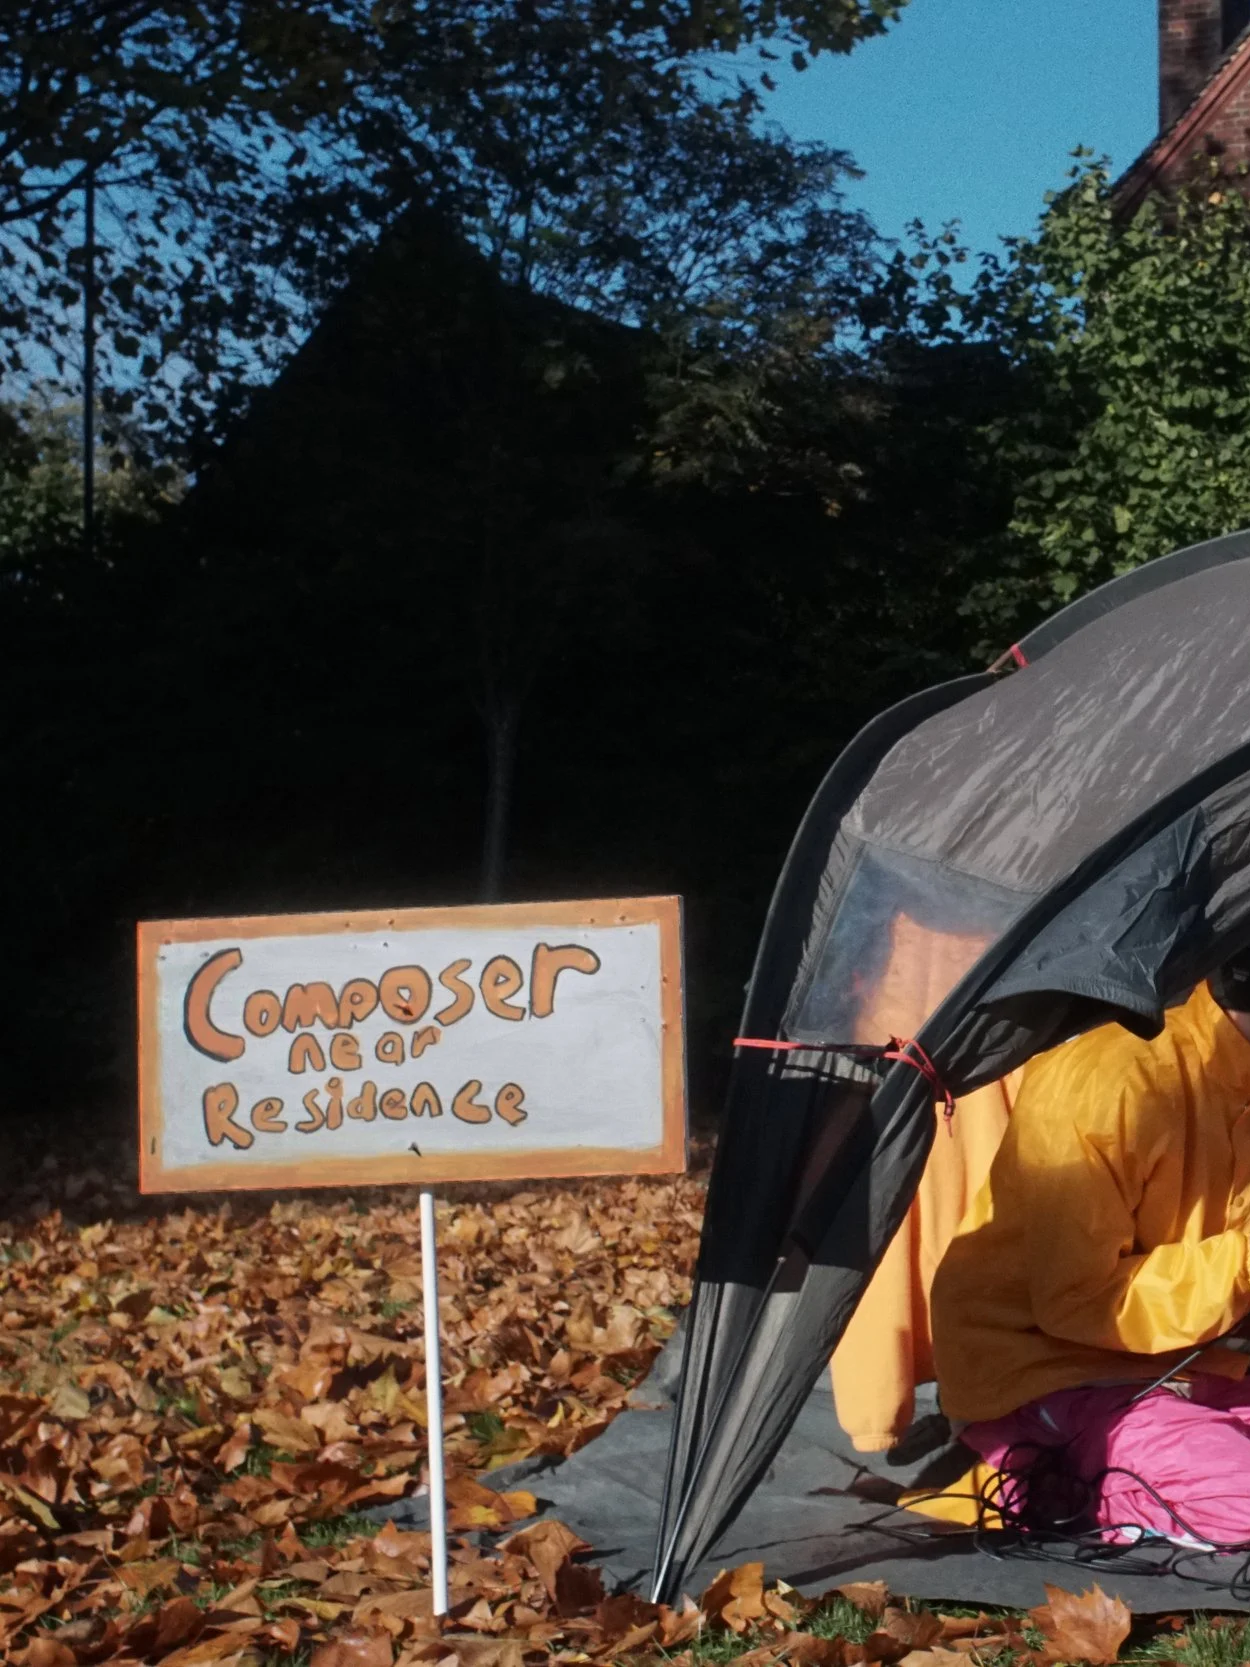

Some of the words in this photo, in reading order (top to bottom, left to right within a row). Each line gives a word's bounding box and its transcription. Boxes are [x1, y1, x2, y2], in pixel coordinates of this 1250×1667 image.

[184, 943, 600, 1062] Composer
[287, 1026, 441, 1074] near
[203, 1077, 527, 1149] Residence
